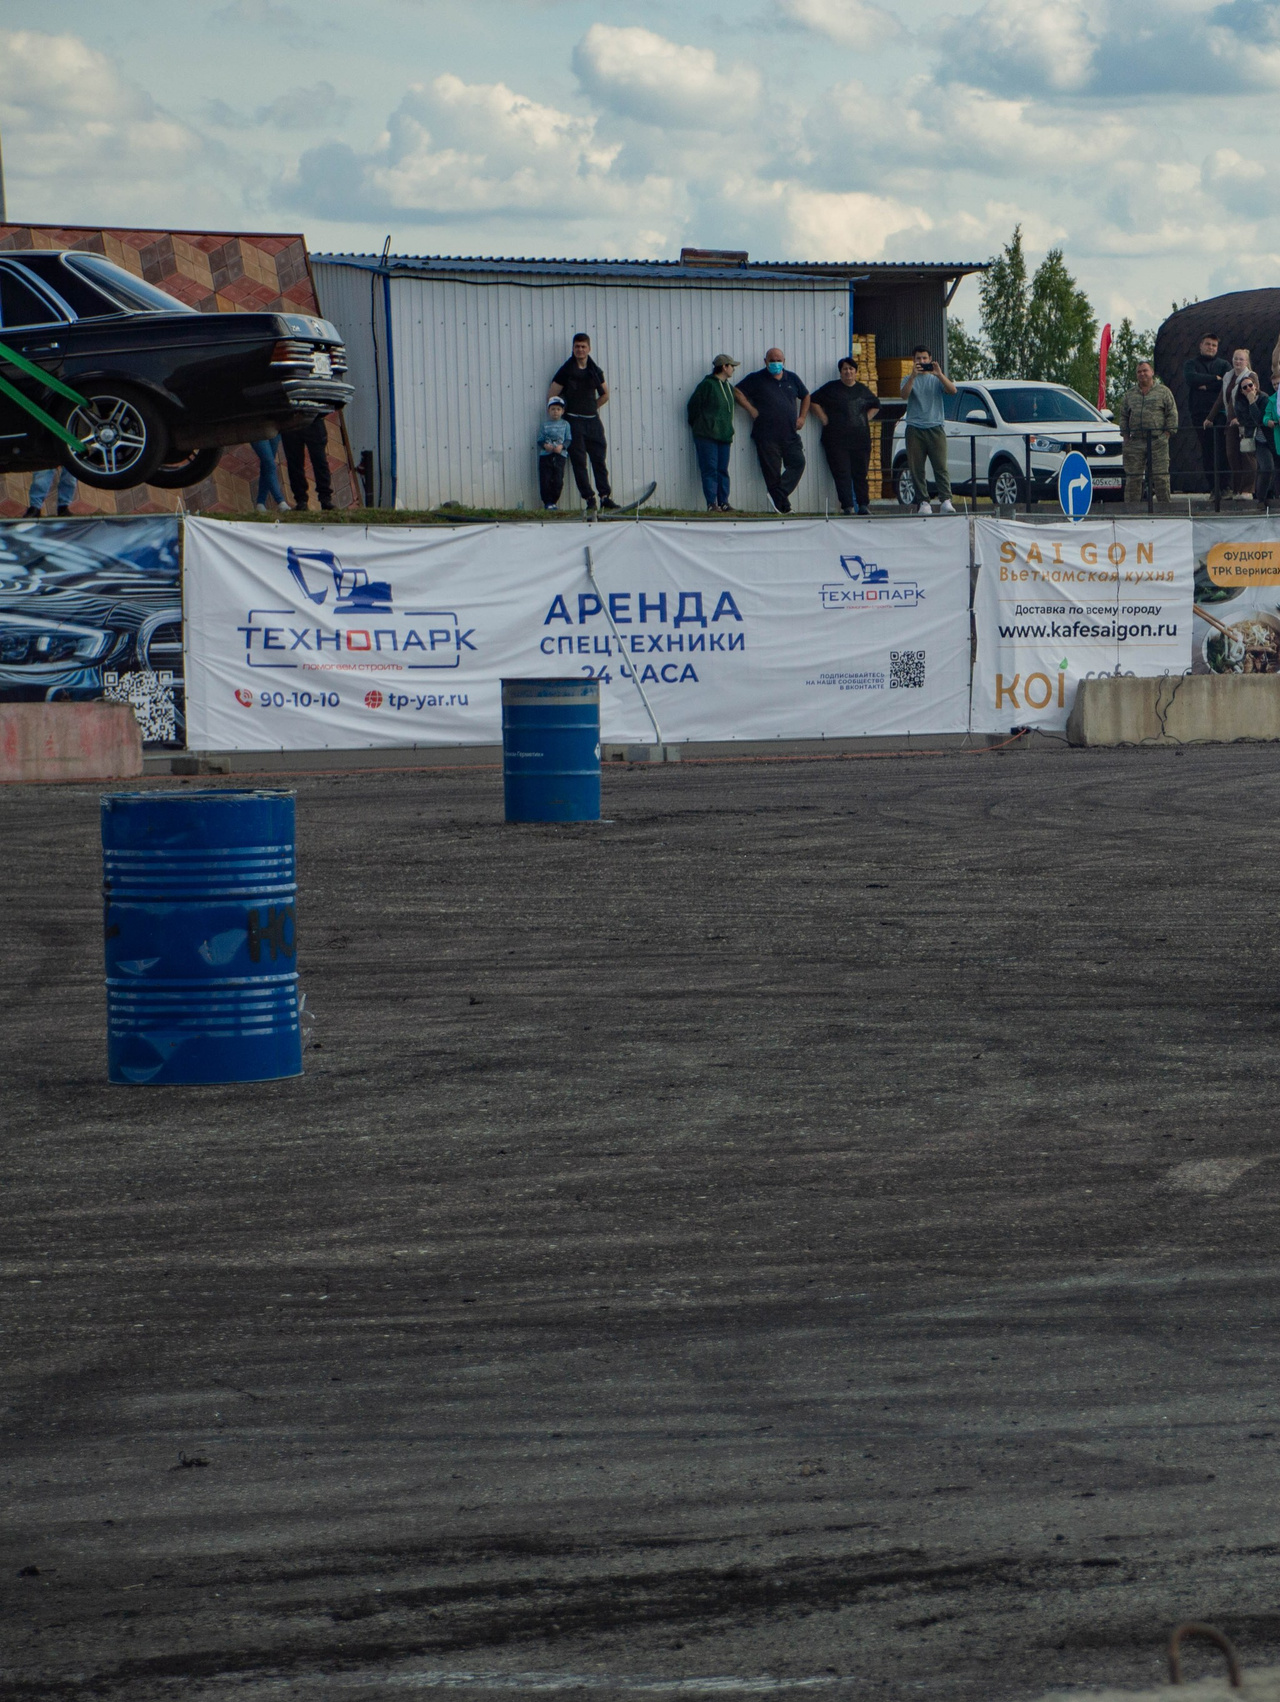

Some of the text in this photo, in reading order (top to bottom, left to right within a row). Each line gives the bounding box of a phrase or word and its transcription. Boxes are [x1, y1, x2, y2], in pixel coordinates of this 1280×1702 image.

[1223, 550, 1274, 564] ФУДКОРТ
[999, 566, 1175, 585] Вьетнамская кухня
[1212, 565, 1233, 576] ТРК
[818, 588, 926, 602] ТЕХНОПАРК
[543, 590, 744, 629] АРЕНДА
[1014, 603, 1162, 618] Доставка по всему городу
[237, 626, 479, 652] ТЕХНОПАРК
[998, 620, 1177, 642] www.kafesaigon.ru
[540, 632, 746, 658] СПЕЦТЕХНИКИ
[358, 663, 404, 673] строить
[581, 663, 700, 685] 24 ЧАСА
[820, 672, 885, 680] ПОДПИСЫВАЙТЕСЬ
[838, 678, 885, 686] СООБЩЕСТВО
[260, 691, 341, 708] 90-10-10
[388, 691, 470, 711] tp-yar.ru
